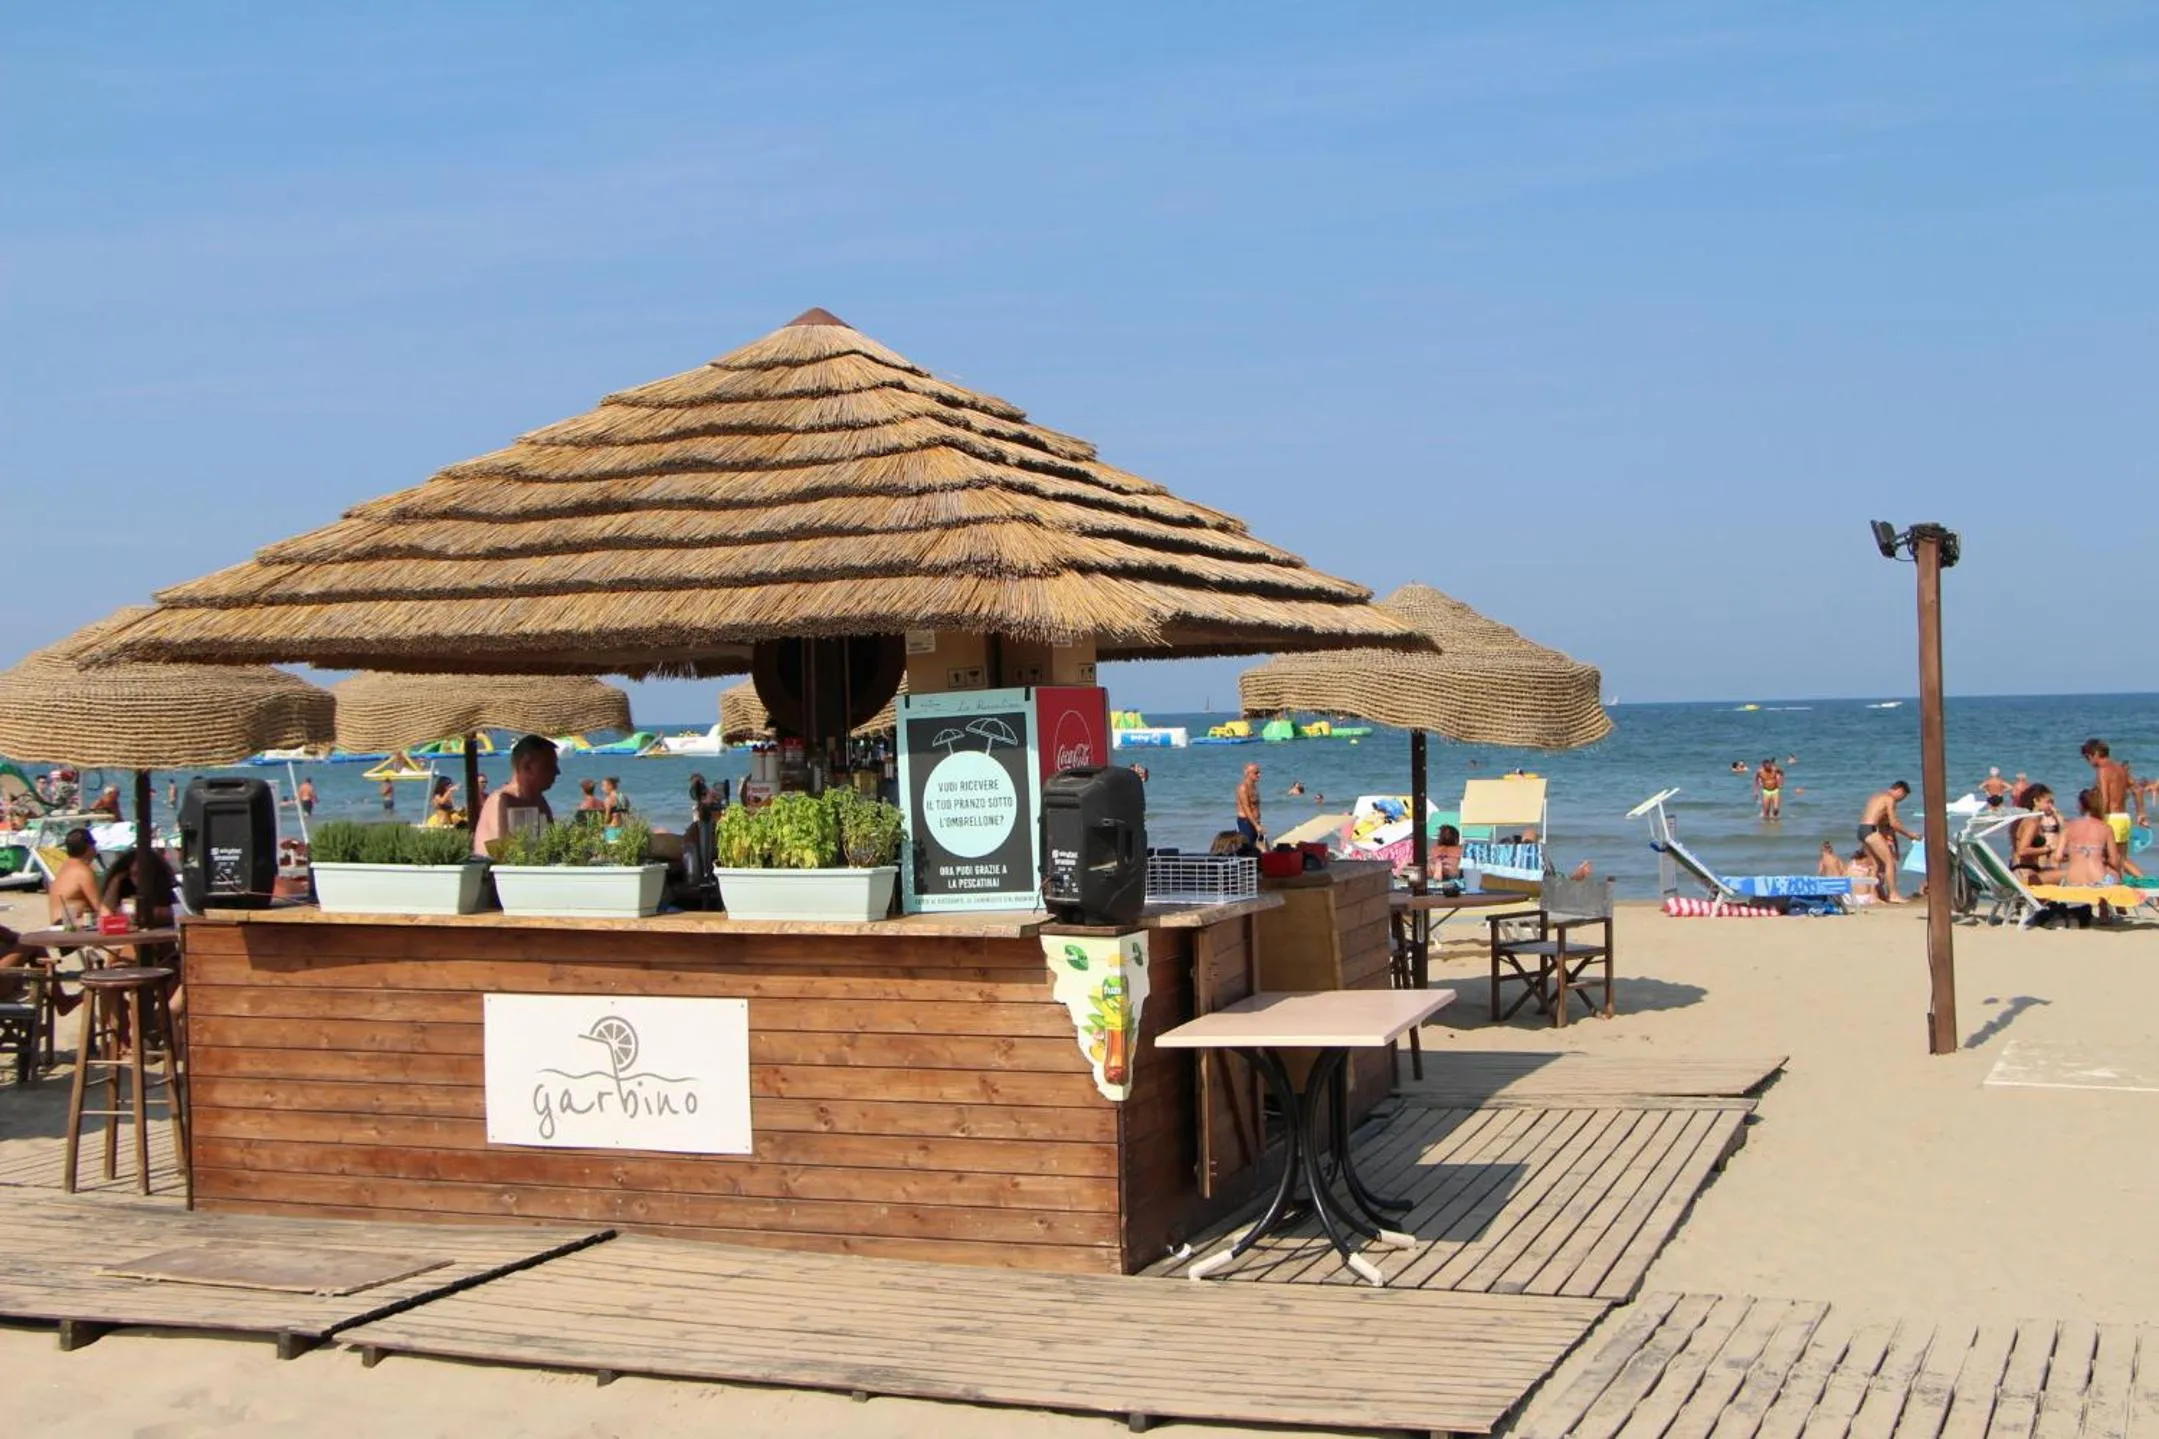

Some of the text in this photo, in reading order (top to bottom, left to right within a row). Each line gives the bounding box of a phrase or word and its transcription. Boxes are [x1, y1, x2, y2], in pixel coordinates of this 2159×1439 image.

[938, 780, 999, 792] VUOI RICEVERE
[927, 797, 1013, 811] IL TUO PRANZO SOTTO
[940, 815, 1004, 828] L'OMBRELLONE?
[939, 864, 1008, 876] ORA PUOI GRAZIE A
[948, 880, 957, 889] LA
[533, 1083, 698, 1139] garbino
